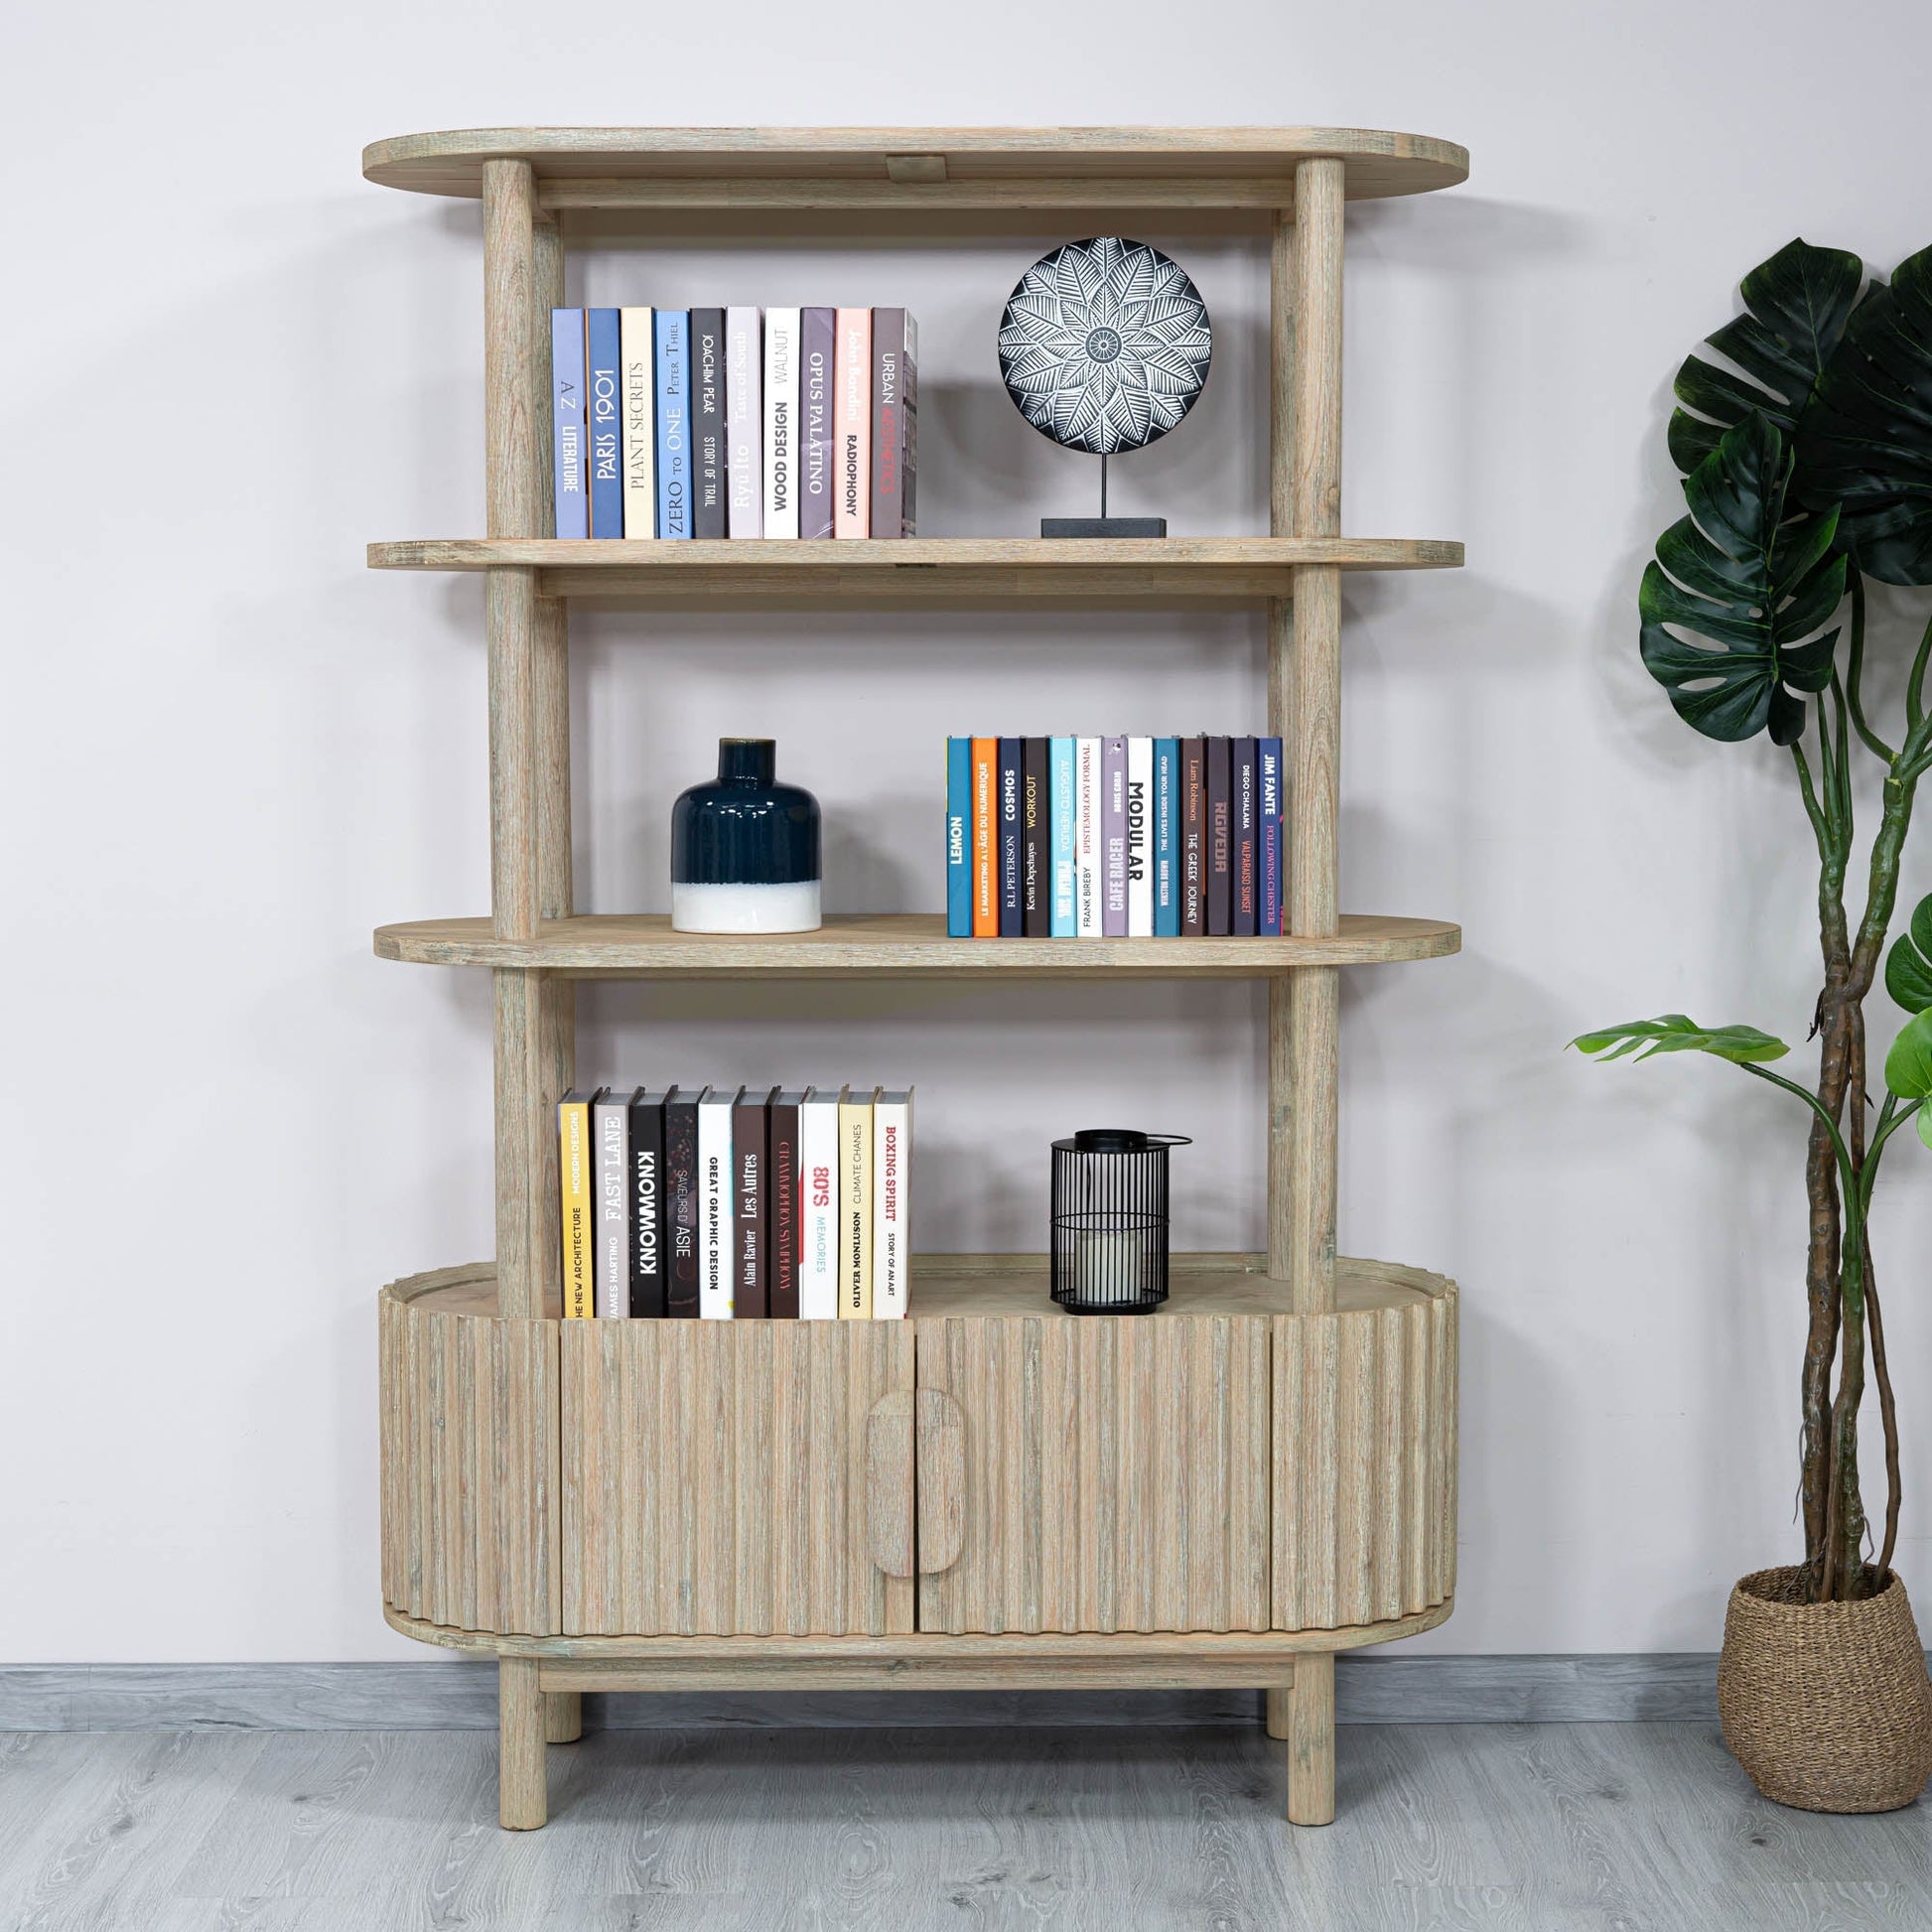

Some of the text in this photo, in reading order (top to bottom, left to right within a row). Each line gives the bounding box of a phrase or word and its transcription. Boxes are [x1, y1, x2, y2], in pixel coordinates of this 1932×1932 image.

[774, 329, 788, 383] WALNUT
[849, 330, 861, 362] John
[561, 381, 575, 409] A Z
[702, 335, 715, 413] JOACHIM PEAR
[882, 353, 895, 403] URBAN
[595, 370, 617, 479] PARIS 1901
[629, 362, 644, 488] PLANT SECRETS
[666, 408, 680, 451] ONE
[810, 352, 823, 494] OPUS PALATINO
[562, 426, 578, 492] LITERATURE
[704, 437, 717, 506] STORY OF TRAIL
[734, 445, 749, 469] Ito
[774, 402, 787, 511] WOOD DESIGN
[847, 435, 857, 516] RADIOPHONY
[669, 482, 683, 533] ZERO
[978, 762, 989, 813] NUMERIQUE
[1006, 769, 1015, 821] COSMOS
[1027, 775, 1035, 828] WORKOUT
[1265, 755, 1275, 814] JIM FANTE
[950, 817, 962, 864] LEMON
[979, 816, 987, 827] DU
[1129, 782, 1144, 881] MODULAR
[1007, 836, 1016, 889] PETERSON
[1109, 838, 1124, 910] CAFE RACER
[981, 907, 988, 916] LE
[1187, 886, 1196, 923] JOURNEY
[1242, 887, 1251, 913] SUNSET
[605, 1117, 621, 1221] FAST LANE
[675, 1170, 688, 1213] SAVEURS
[741, 1154, 757, 1218] Les Autres
[813, 1167, 829, 1206] 80'S
[886, 1127, 896, 1221] BOXING SPIRIT
[675, 1226, 691, 1257] ASIE
[709, 1198, 718, 1245] GRAPHIC
[817, 1216, 826, 1273] MEMORIES
[709, 1251, 718, 1290] DESIGN
[745, 1230, 757, 1286] Alain Ravier
[889, 1259, 895, 1268] OF
[889, 1270, 895, 1280] AN
